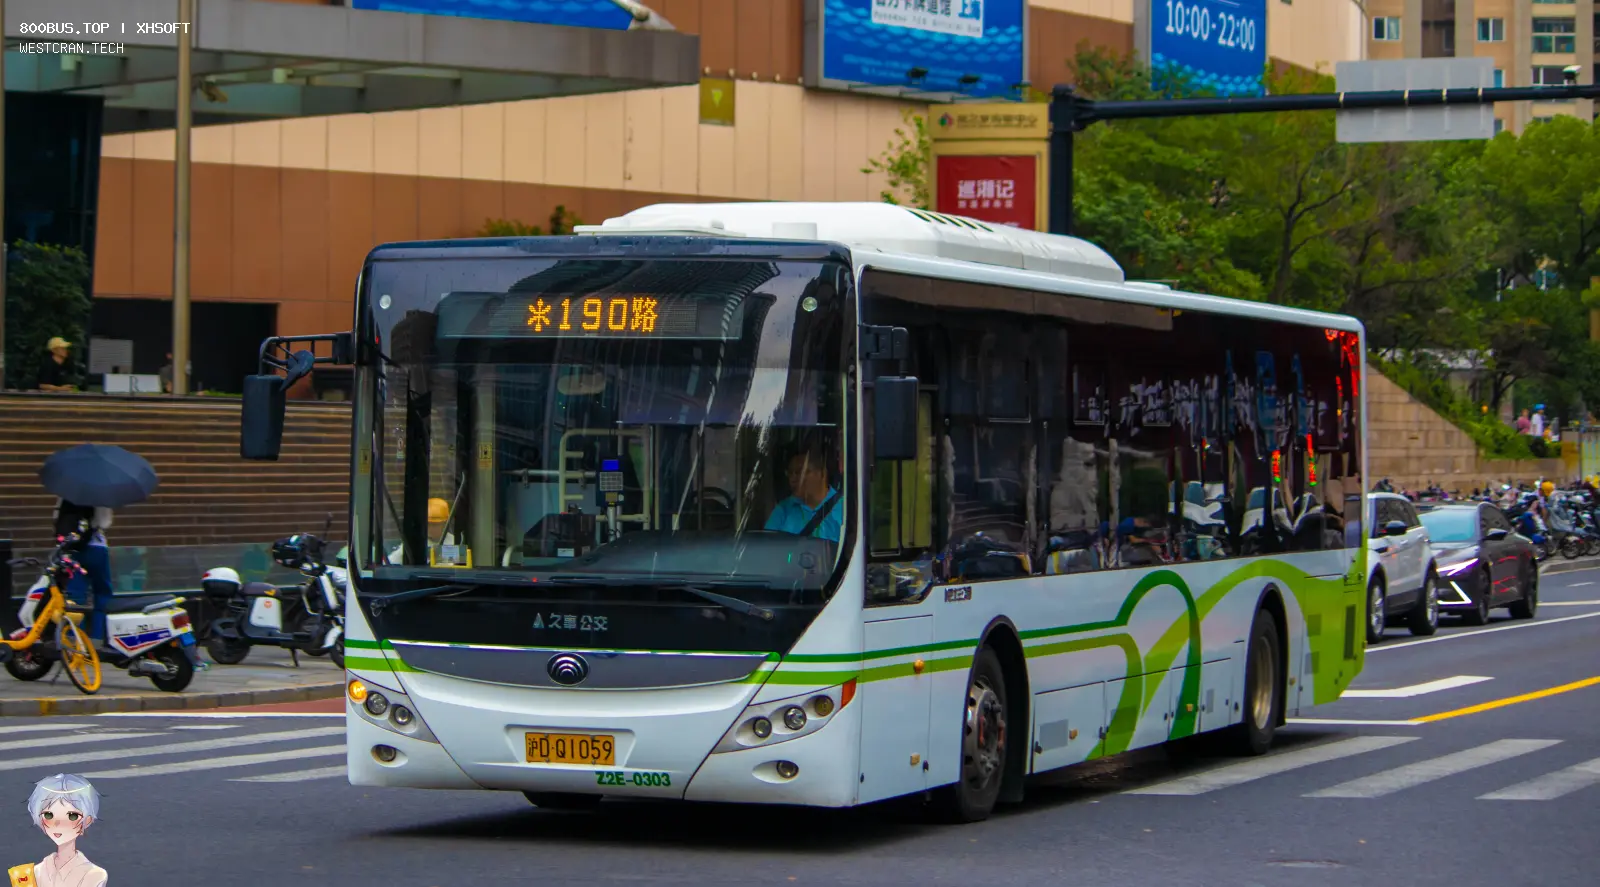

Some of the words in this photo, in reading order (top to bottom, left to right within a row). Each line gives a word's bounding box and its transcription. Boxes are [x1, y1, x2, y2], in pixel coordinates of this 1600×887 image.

[548, 612, 608, 631] 久事公交
[595, 771, 671, 786] Z2E-0303
